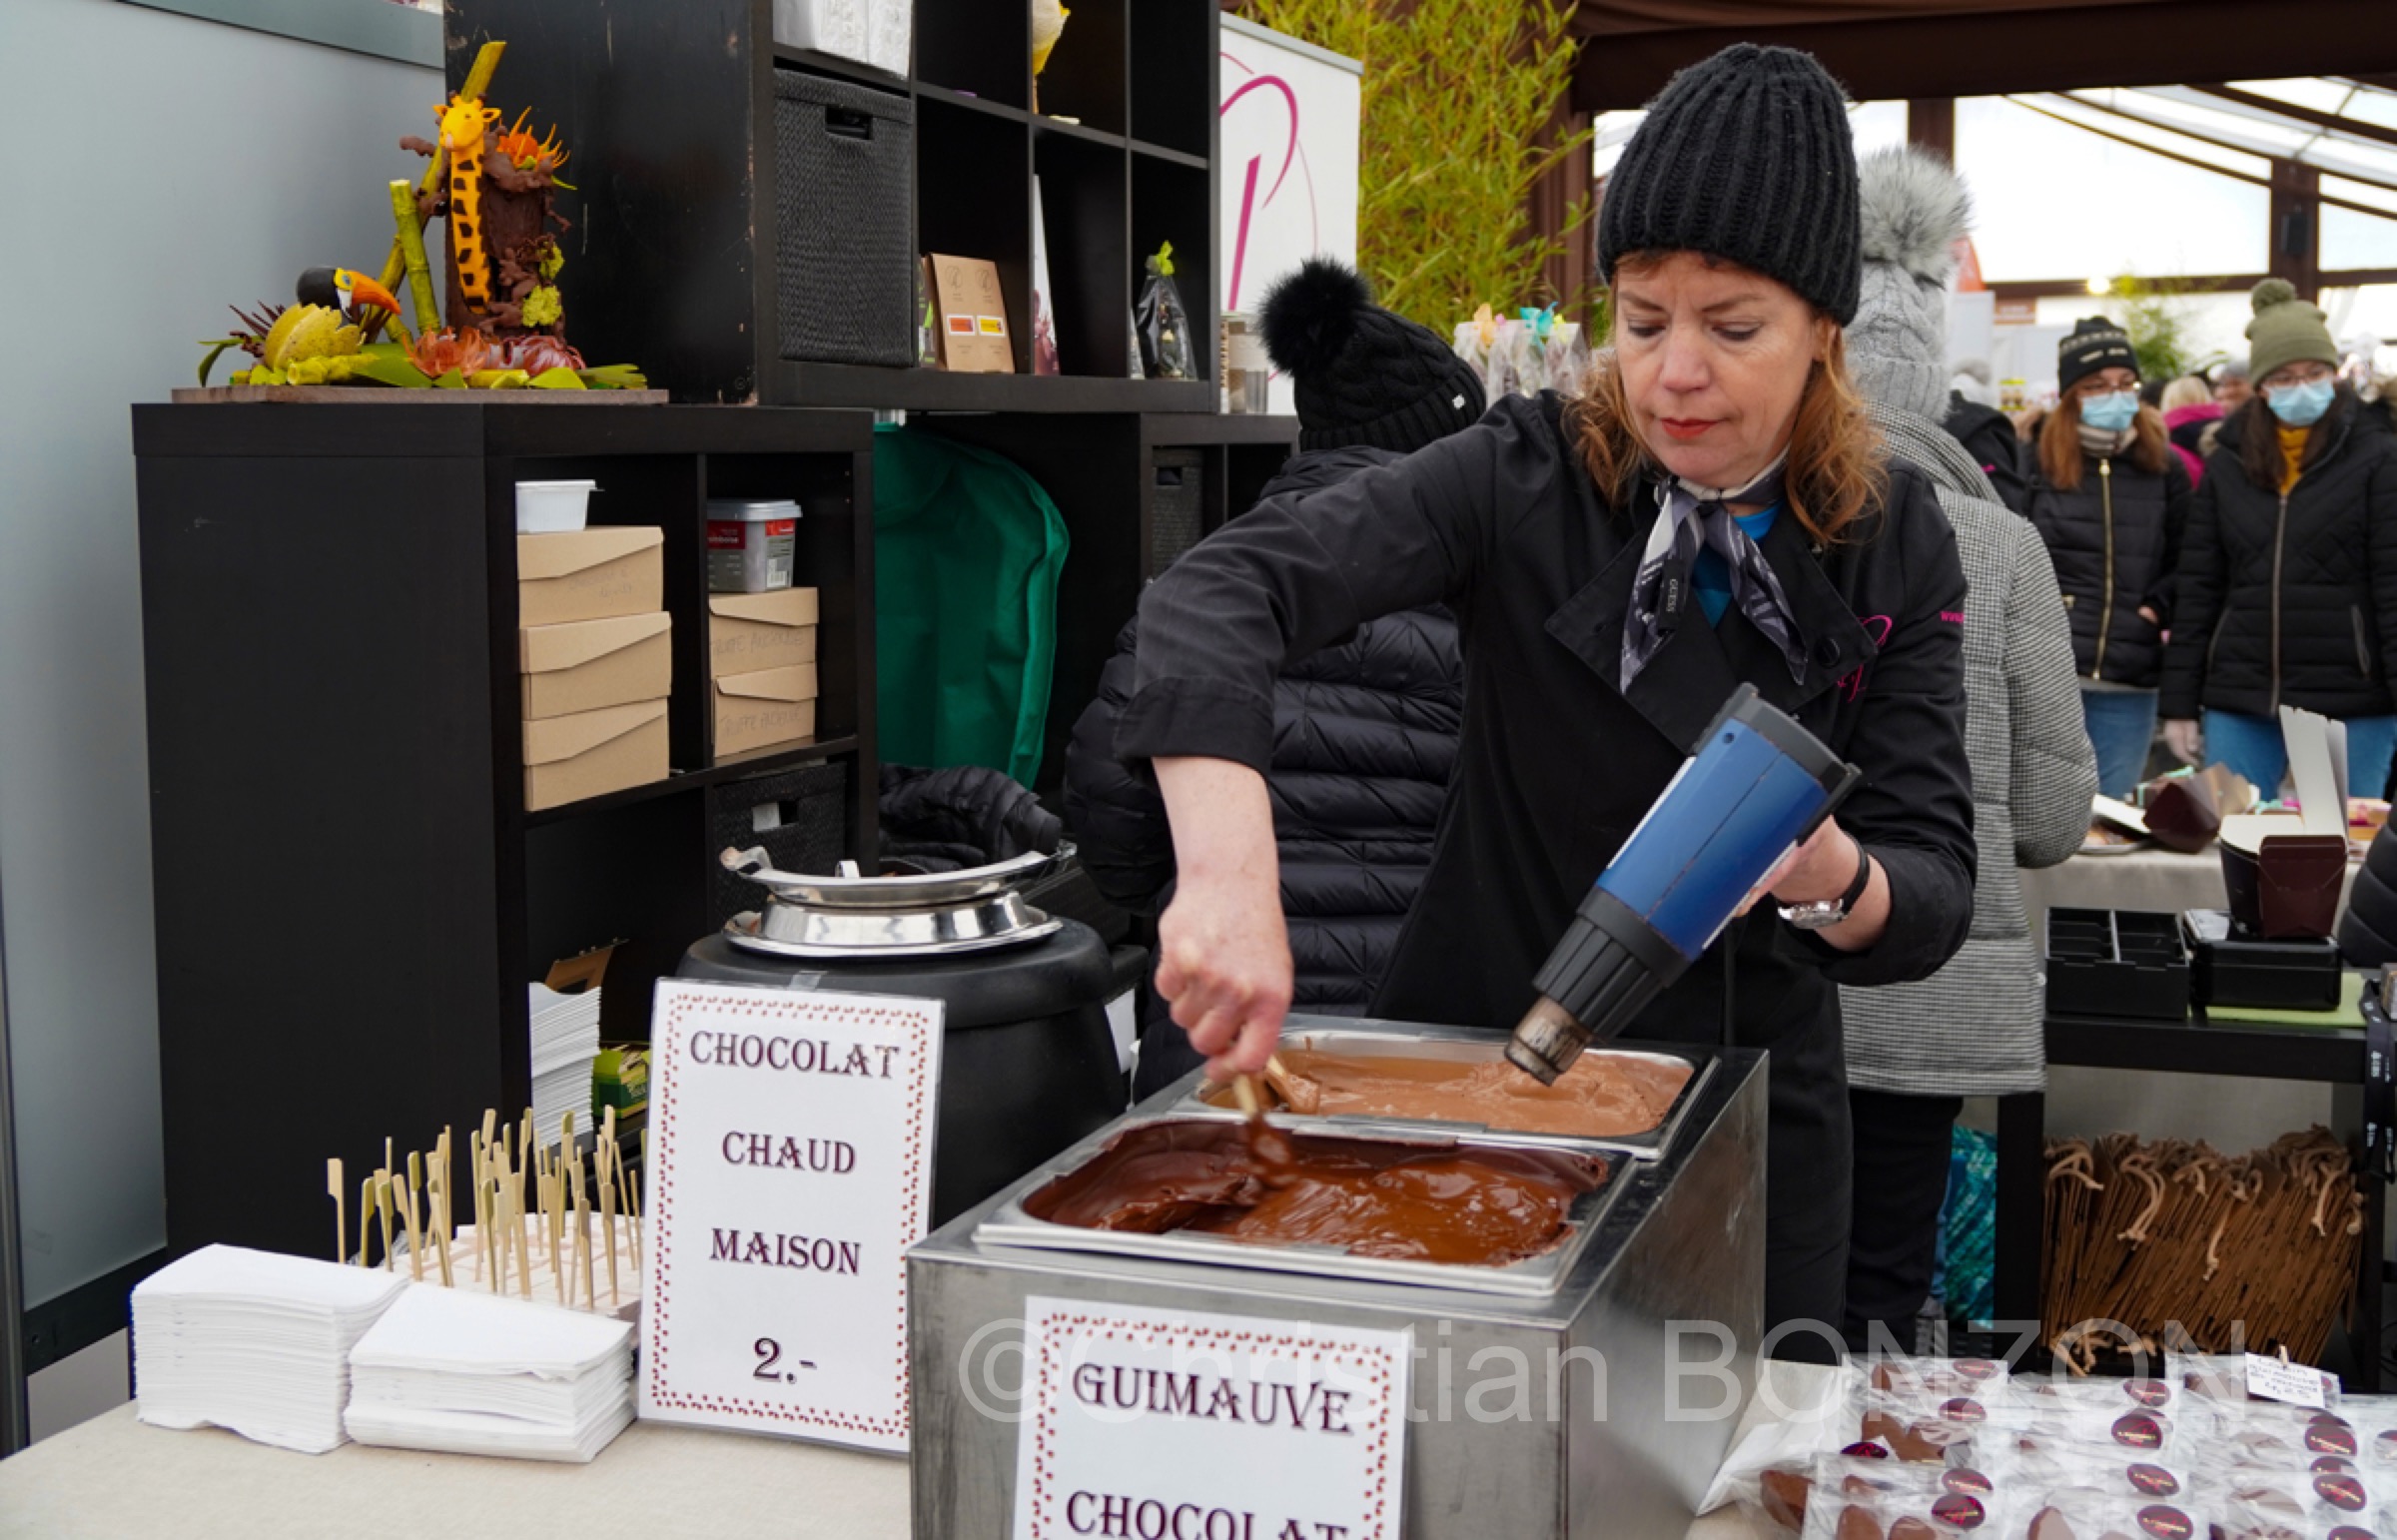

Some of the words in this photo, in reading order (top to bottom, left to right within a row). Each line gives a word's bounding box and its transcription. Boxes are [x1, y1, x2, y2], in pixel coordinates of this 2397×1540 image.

[689, 1030, 901, 1080] CHOCOLAT
[721, 1131, 857, 1174] CHAUD
[710, 1227, 862, 1276] MAISON
[752, 1337, 818, 1384] 2.-
[1072, 1362, 1353, 1434] GUIMAUVE
